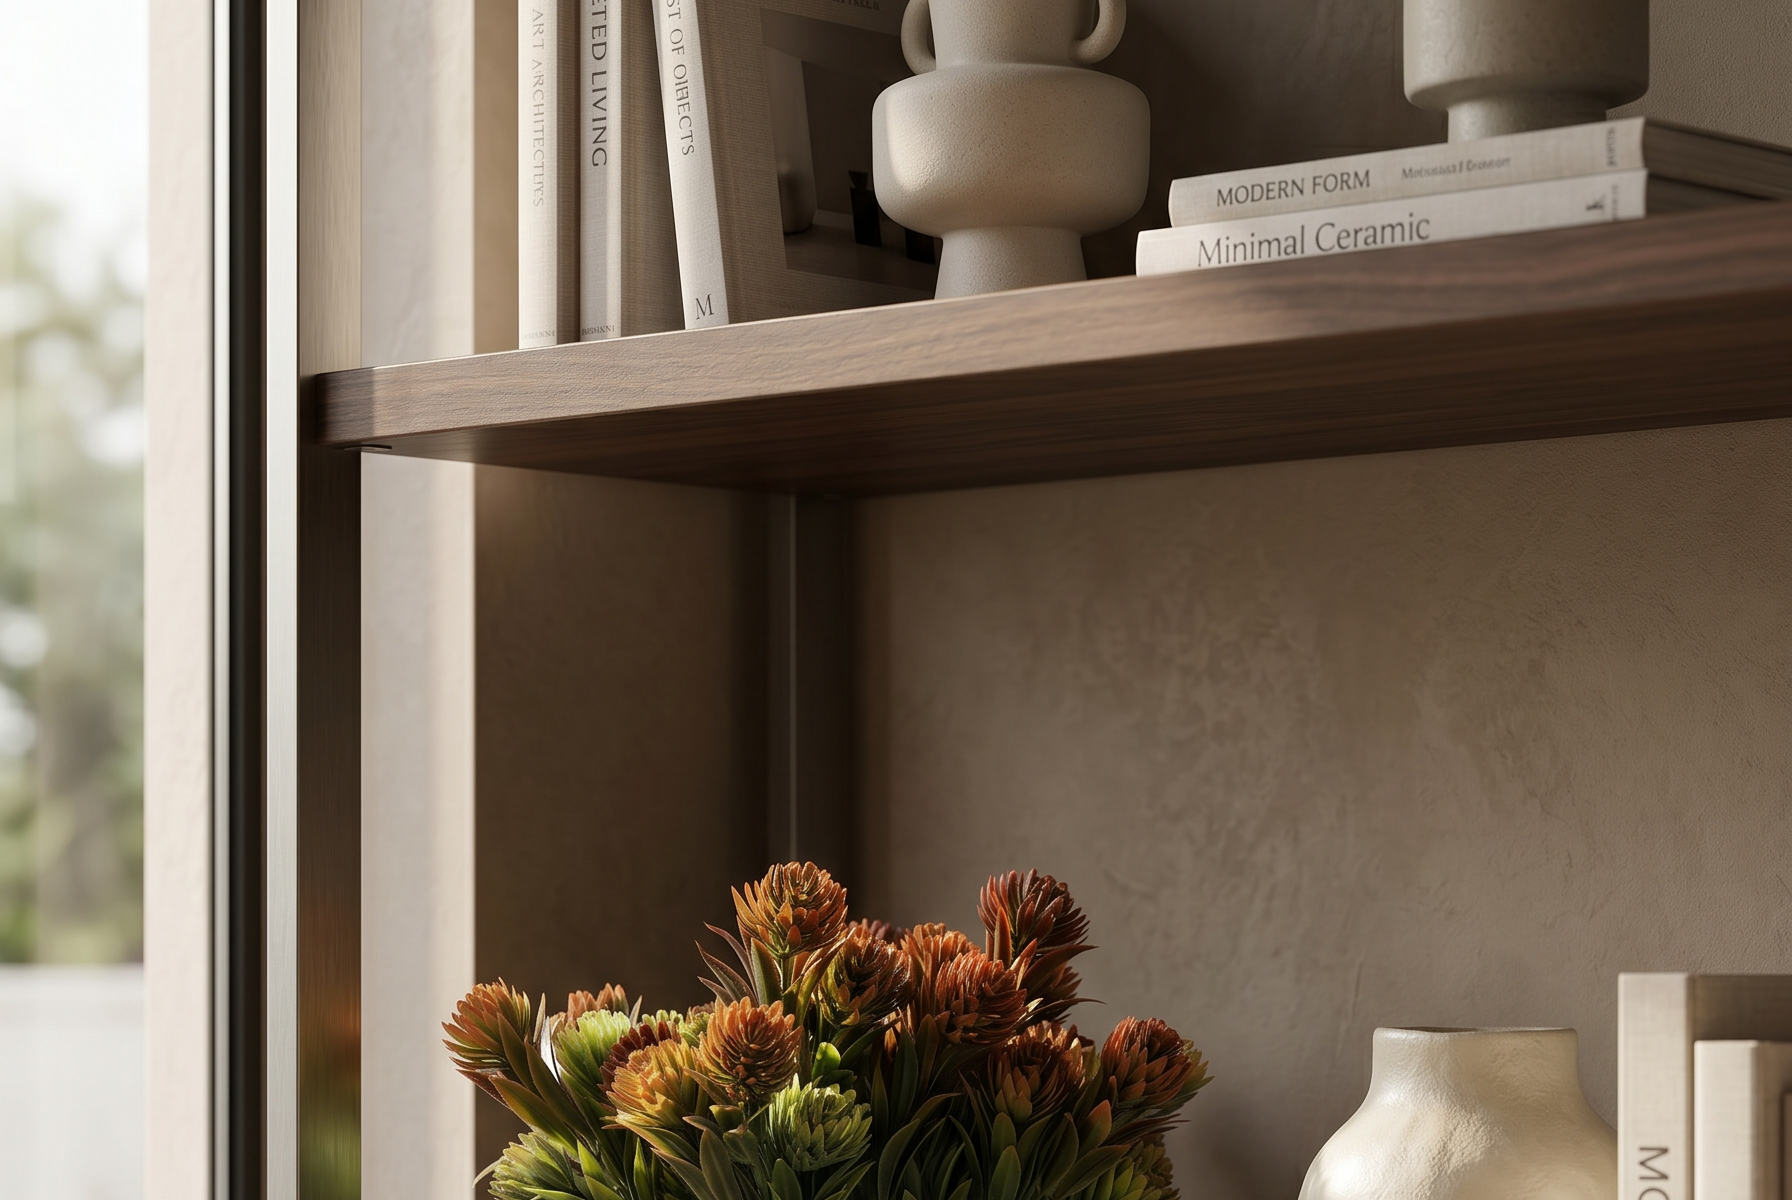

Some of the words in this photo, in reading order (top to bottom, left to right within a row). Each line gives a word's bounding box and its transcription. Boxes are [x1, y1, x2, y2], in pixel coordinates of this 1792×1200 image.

[533, 8, 545, 50] ART
[670, 28, 685, 55] OF
[591, 70, 607, 167] LIVING
[1216, 178, 1305, 207] MODERN
[1312, 169, 1371, 195] FORM
[1197, 224, 1306, 267] Minimal
[1314, 212, 1431, 252] Ceramic
